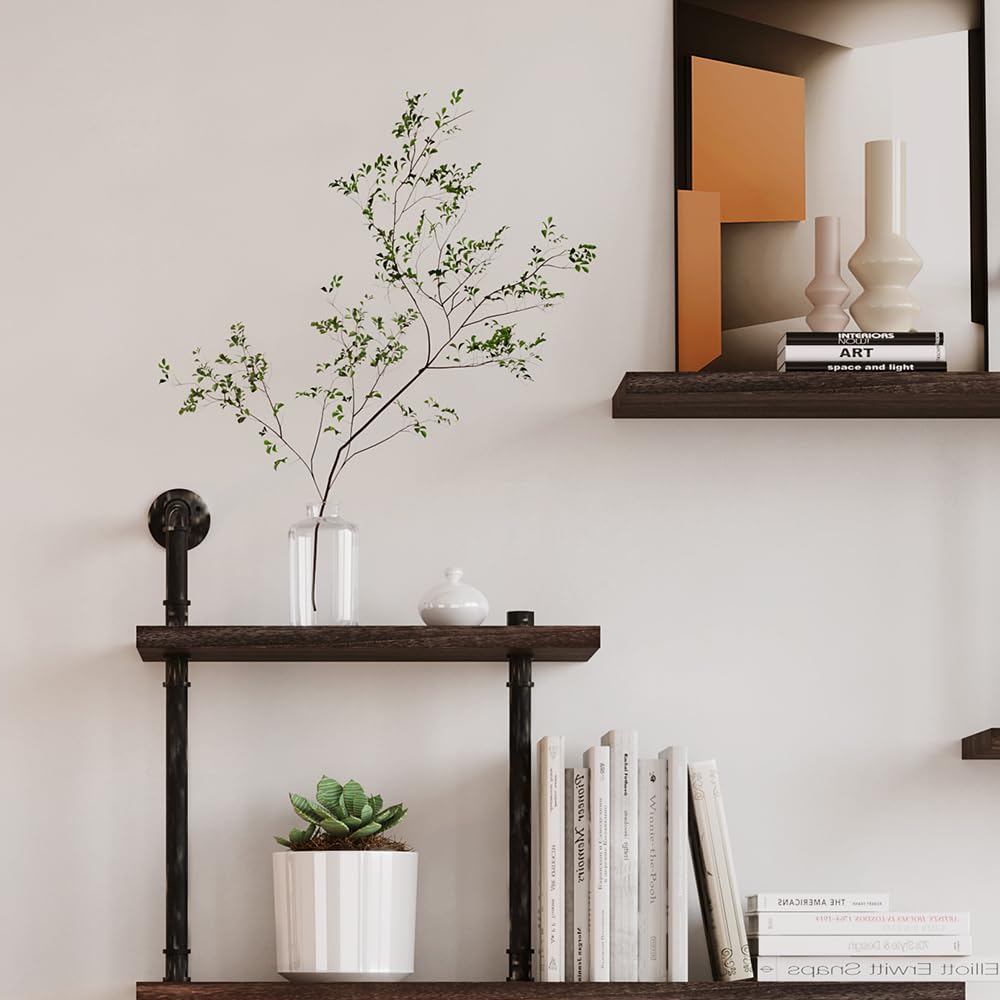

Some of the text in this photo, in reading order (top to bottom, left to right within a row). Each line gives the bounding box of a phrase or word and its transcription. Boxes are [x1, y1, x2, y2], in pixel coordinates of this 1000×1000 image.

[839, 348, 874, 358] ART
[827, 363, 915, 372] space and light
